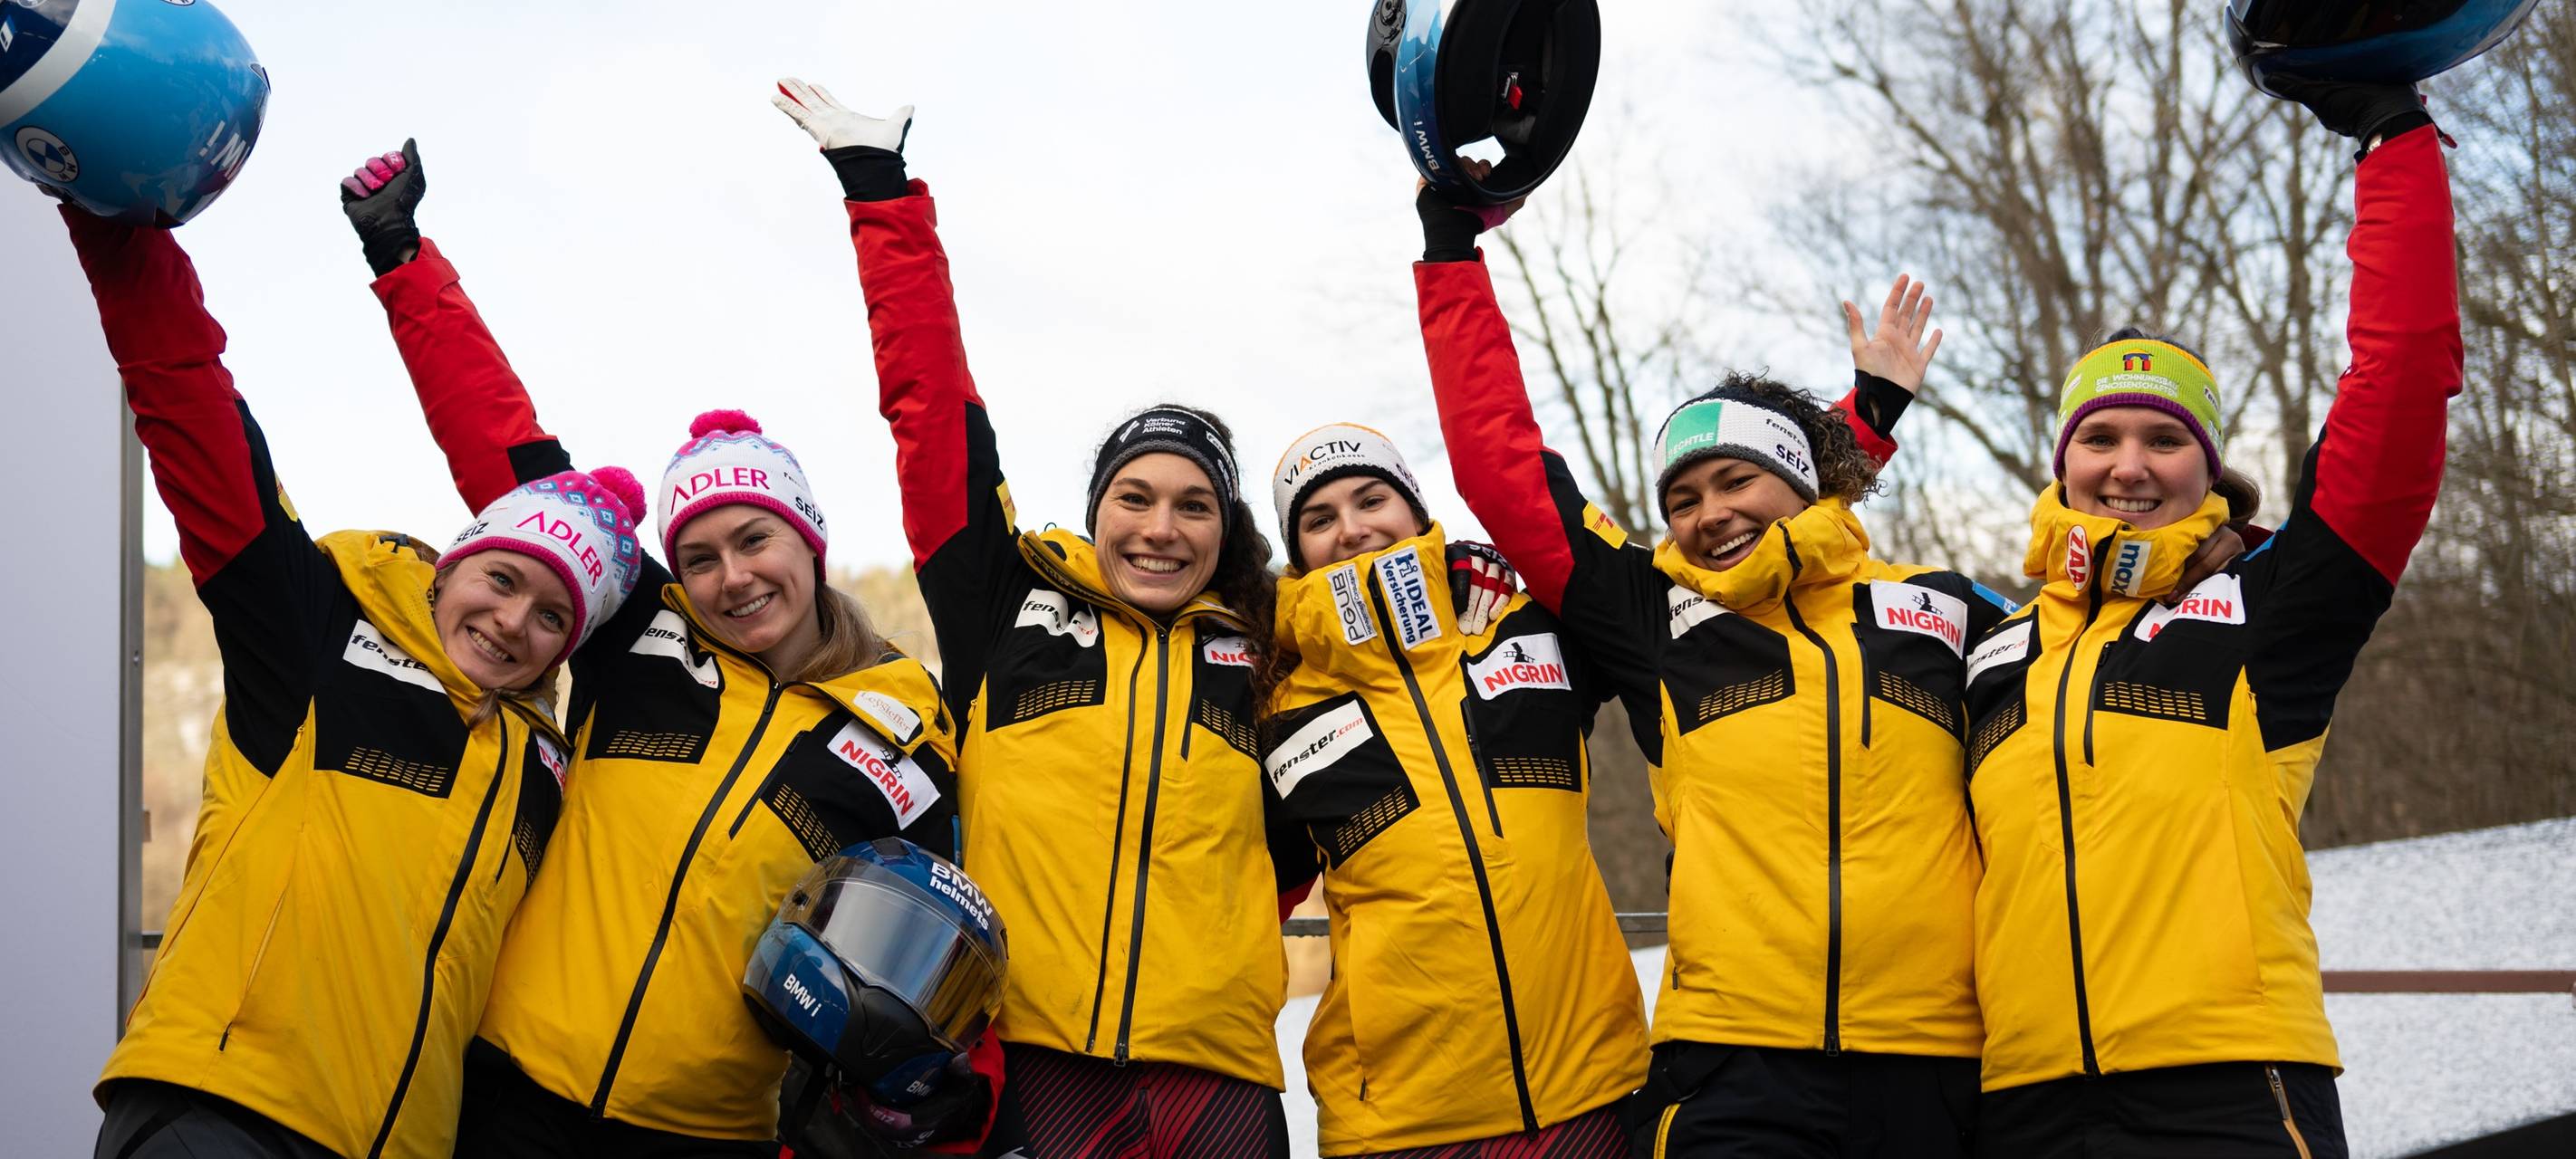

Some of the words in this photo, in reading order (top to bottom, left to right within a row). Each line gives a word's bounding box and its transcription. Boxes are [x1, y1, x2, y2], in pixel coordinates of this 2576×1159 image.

[1416, 130, 1440, 170] BMW
[1142, 426, 1183, 435] Athleten
[1146, 417, 1186, 426] Verbund
[1284, 440, 1361, 485] VIACTIV
[1775, 444, 1810, 478] SEIZ
[670, 467, 770, 515] ADLER
[795, 496, 823, 531] SEIZ
[516, 511, 602, 587] ADLER
[1332, 572, 1365, 641] PGUB
[1383, 560, 1416, 644] Versicherung
[1404, 578, 1433, 638] IDEAL
[1886, 608, 1961, 648] NIGRIN
[351, 635, 433, 674] fenste
[1484, 663, 1563, 692] NIGRIN
[1273, 717, 1363, 784] fenster.com
[840, 740, 914, 816] NIGRIN
[929, 876, 989, 931] helmets
[931, 862, 993, 916] BMW
[783, 973, 816, 1010] BMW
[811, 1003, 822, 1017] i
